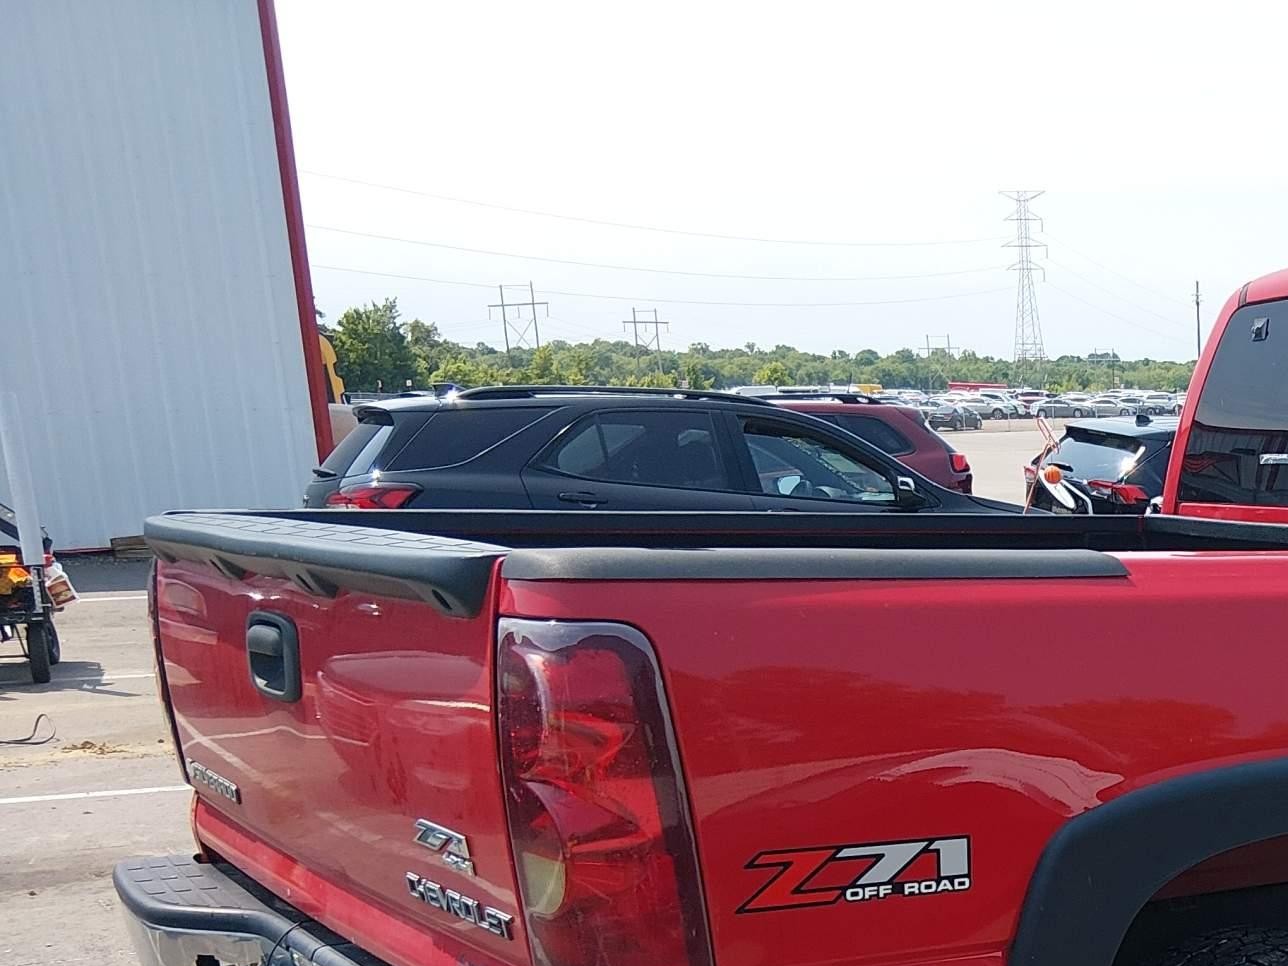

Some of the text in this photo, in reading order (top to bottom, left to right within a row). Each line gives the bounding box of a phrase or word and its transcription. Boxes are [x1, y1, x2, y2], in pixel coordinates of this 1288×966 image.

[406, 871, 513, 939] CHEVROLET
[735, 834, 971, 914] Z71
[845, 877, 970, 901] OFF ROAD
